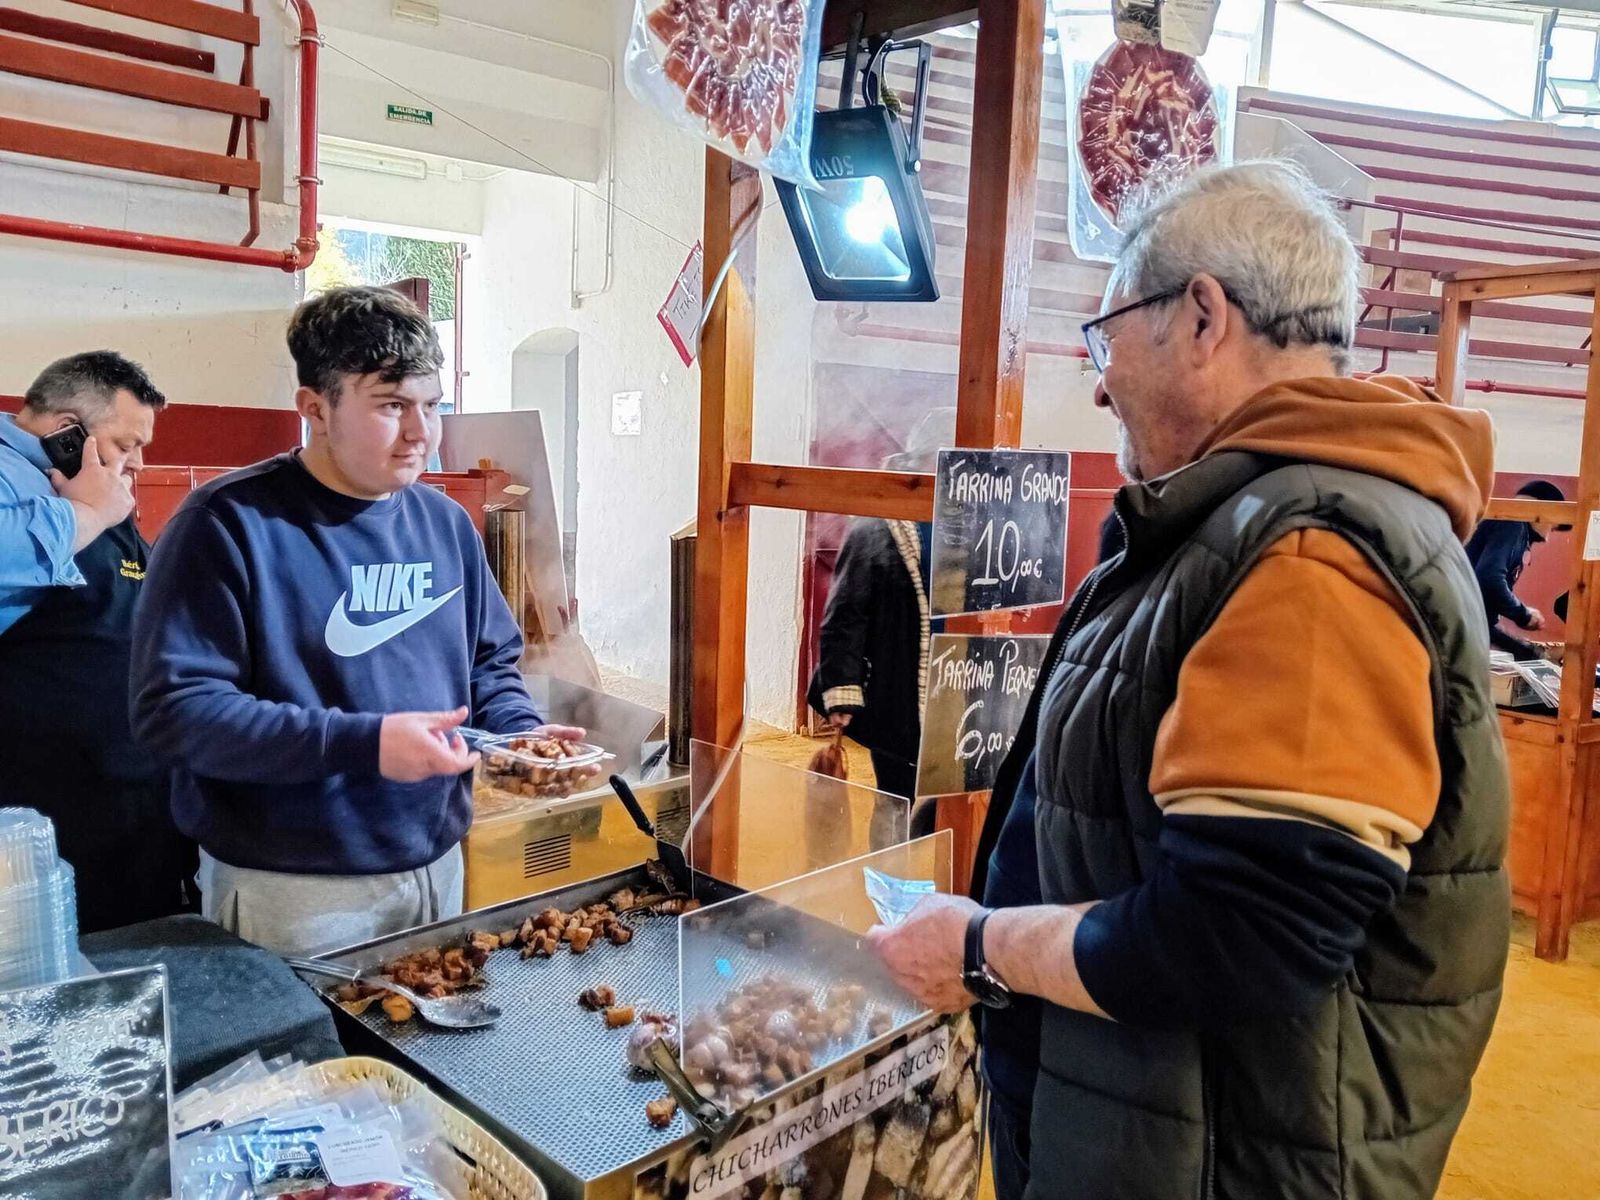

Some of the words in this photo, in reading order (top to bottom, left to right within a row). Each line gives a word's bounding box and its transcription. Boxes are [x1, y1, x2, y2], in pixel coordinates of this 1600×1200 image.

[389, 112, 431, 125] EMERGENCIA
[815, 155, 854, 177] 50W
[348, 561, 433, 612] NIKE
[999, 640, 1040, 698] PEQUE
[693, 1086, 863, 1194] CHICHARRONES
[867, 1037, 946, 1101] IBÉRICOS
